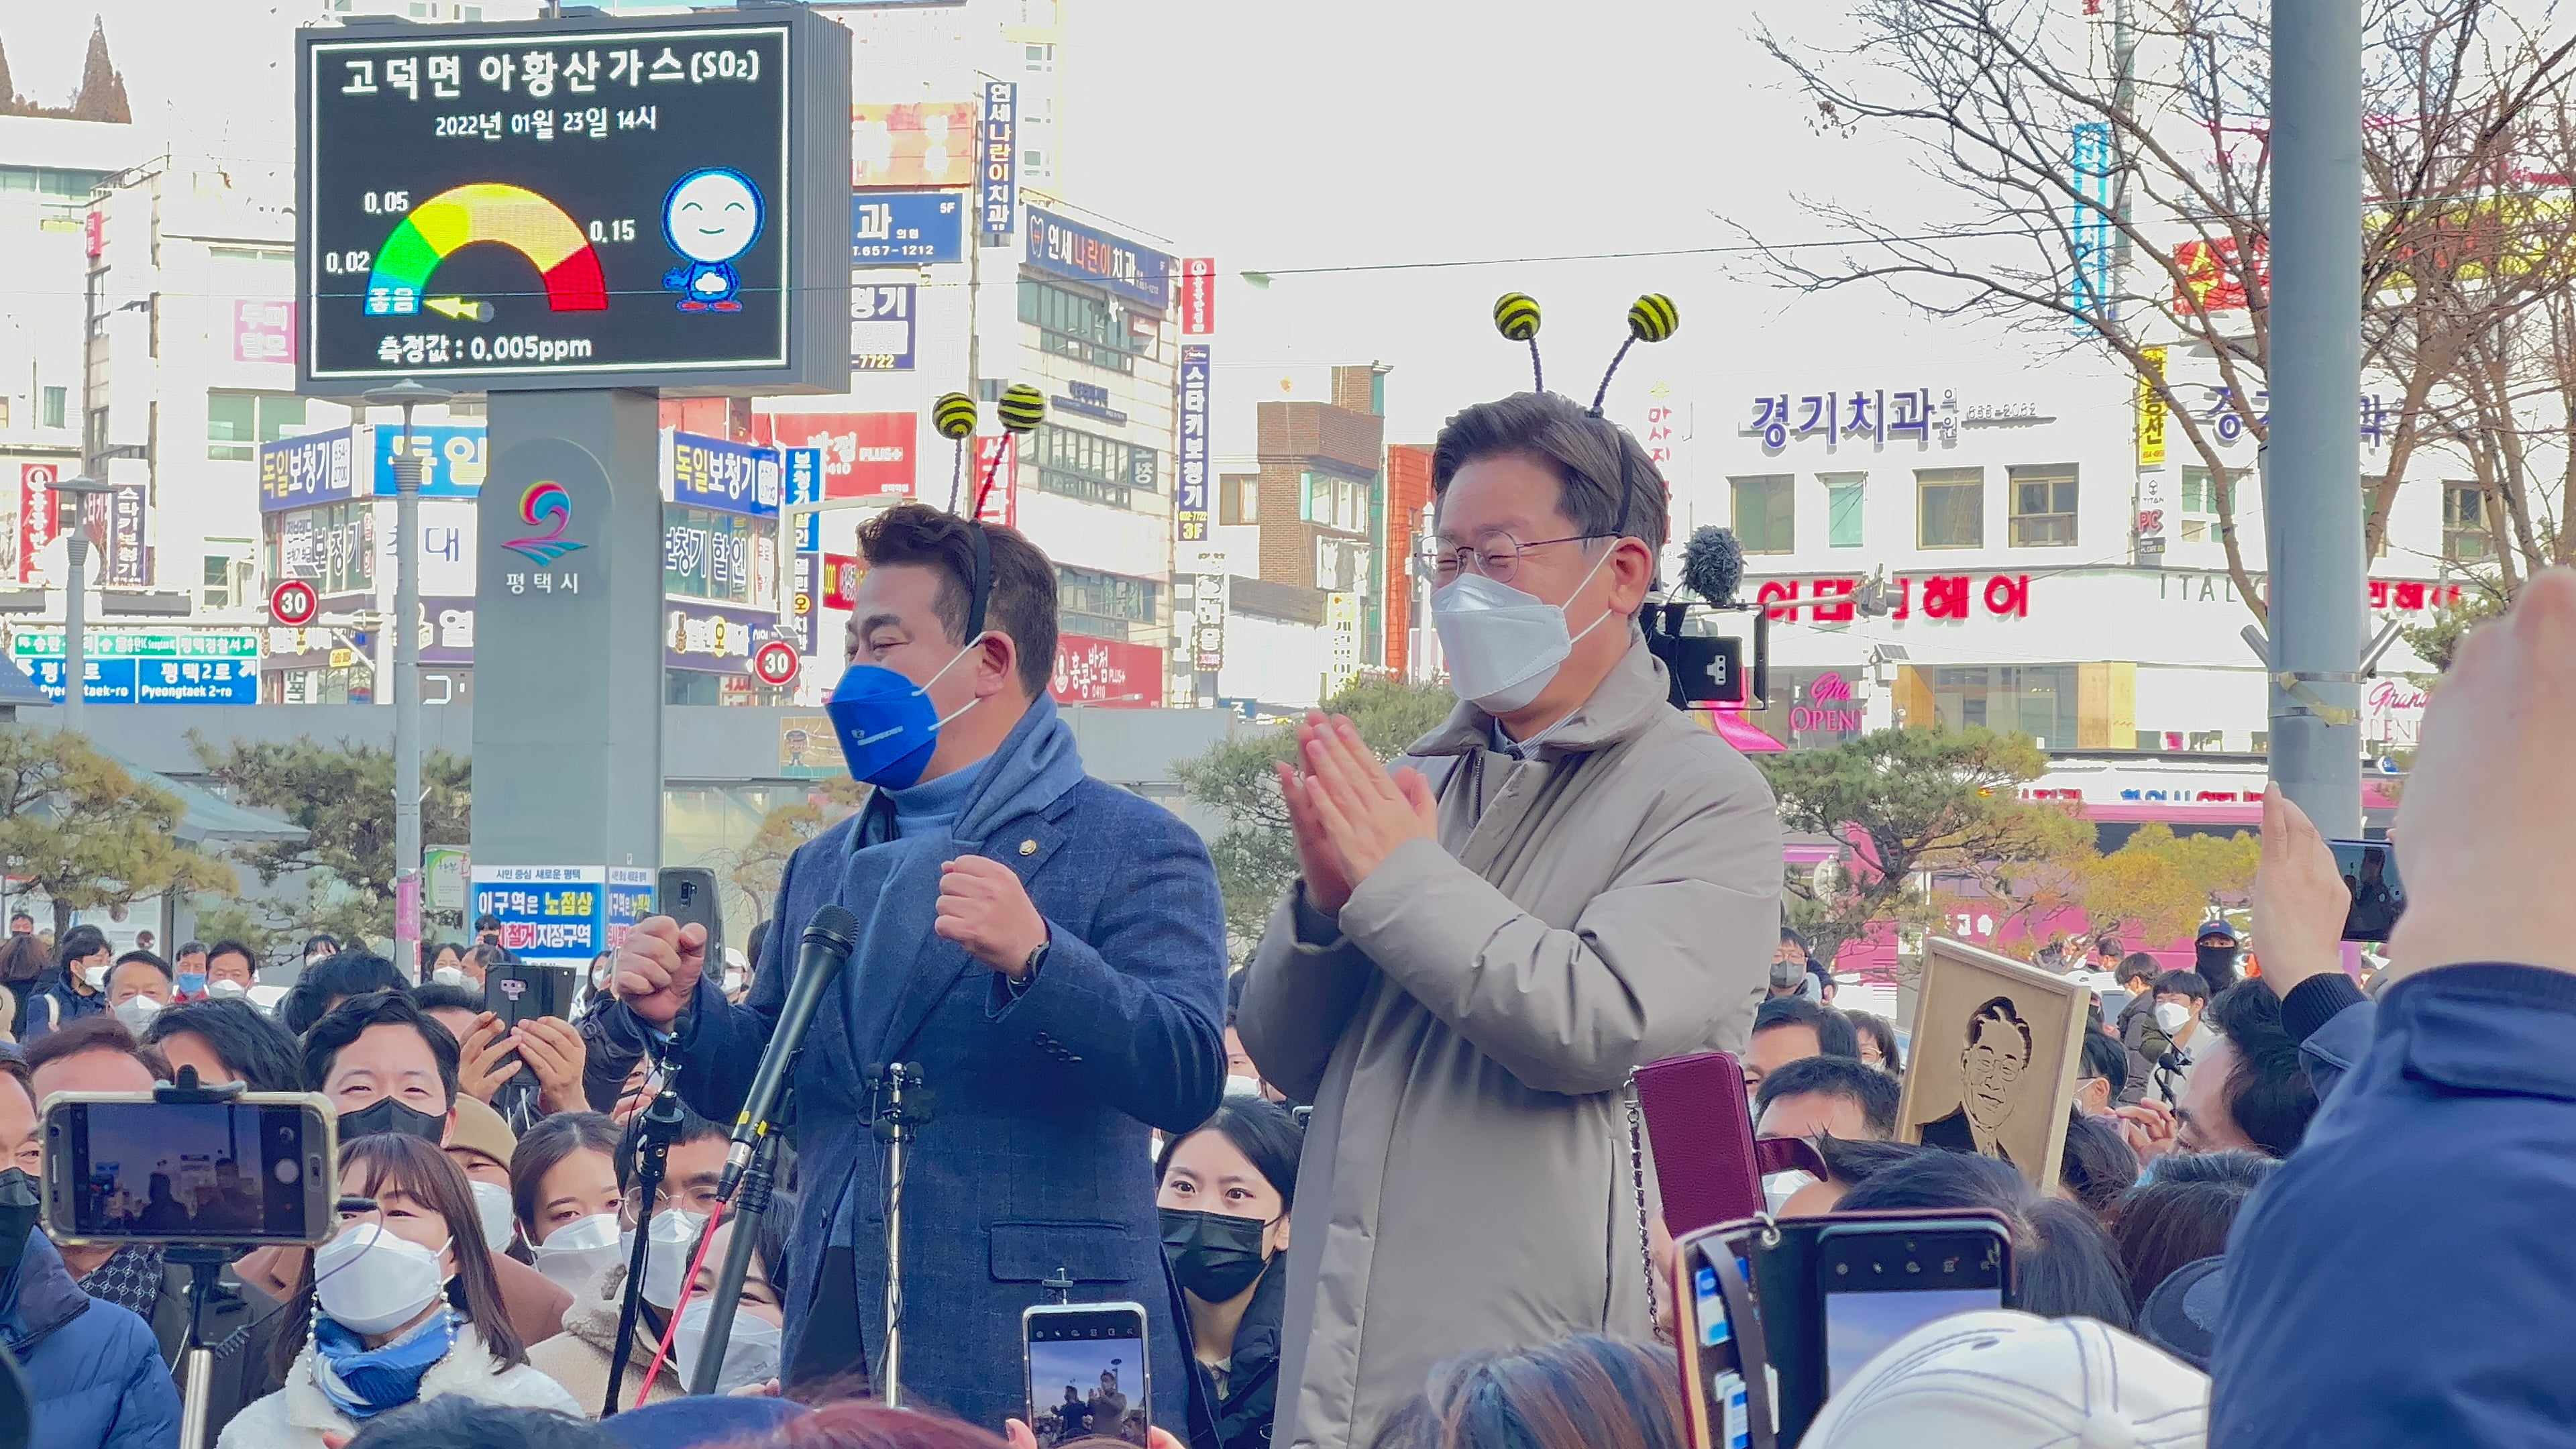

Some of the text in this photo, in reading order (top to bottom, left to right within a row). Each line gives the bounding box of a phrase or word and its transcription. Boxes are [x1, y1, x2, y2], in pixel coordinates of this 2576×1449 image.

[341, 53, 461, 99] 고덕면
[435, 106, 656, 139] 2022년 01월 23일 14시
[987, 84, 1011, 222] 연세나란이치과
[364, 192, 409, 214] 0.05
[940, 203, 955, 213] 5F
[589, 219, 635, 242] 0.15
[326, 251, 370, 273] 0.02
[1048, 224, 1136, 286] 연세나란이치과
[368, 288, 419, 312] 좋음
[470, 339, 592, 360] 0.005ppm
[1751, 387, 1935, 448] 경기치과
[1184, 366, 1205, 508] 스타키보청기
[1648, 405, 1672, 463] 마사지
[262, 441, 329, 499] 독일보청기
[676, 444, 755, 502] 독일보청기
[825, 462, 851, 475] 410
[1183, 523, 1203, 539] 3F
[2139, 511, 2163, 532] PC
[314, 521, 361, 576] 보청기
[712, 532, 747, 586] 할인
[506, 573, 578, 595] 평택시
[282, 592, 306, 613] 30
[1757, 574, 2031, 623] 이태헤어
[41, 662, 232, 684] 평로 평택2로
[765, 653, 788, 674] 30
[142, 684, 207, 699] Pyeongtaek
[209, 684, 233, 698] 2-ro
[496, 869, 581, 880] 시민 중심 새로운 평택
[478, 891, 539, 915] 이구역은
[544, 891, 593, 916] 노점상
[537, 923, 592, 949] 지정구역
